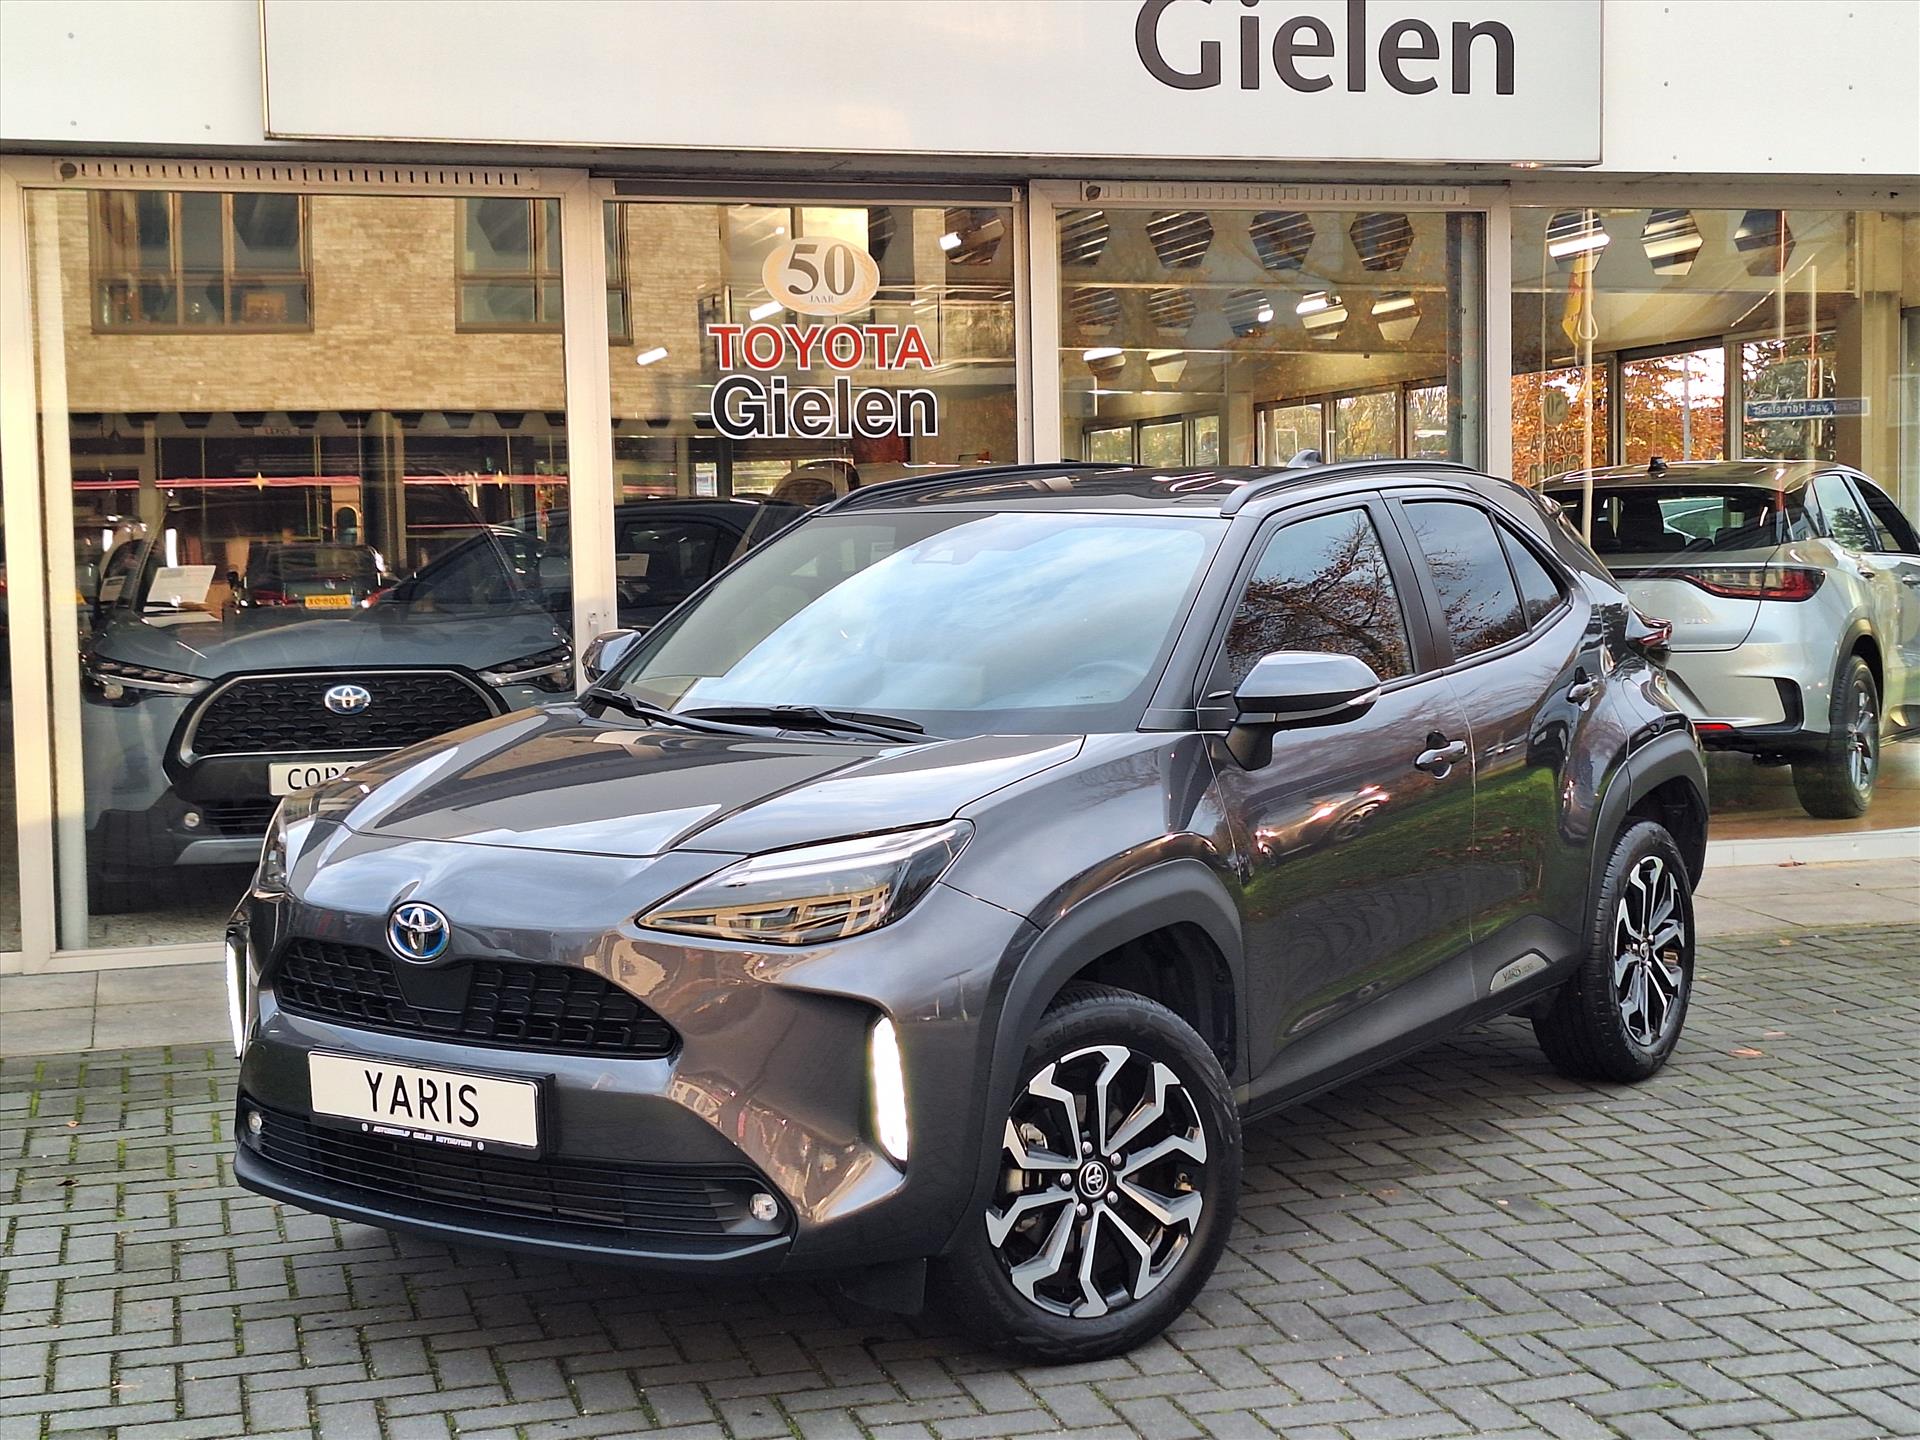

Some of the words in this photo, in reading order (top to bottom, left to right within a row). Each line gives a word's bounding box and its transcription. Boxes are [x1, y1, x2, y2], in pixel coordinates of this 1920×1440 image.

[1135, 0, 1515, 95] Gielen
[788, 243, 855, 296] 50
[808, 294, 835, 303] JAAR
[706, 324, 934, 371] TOYOTA
[712, 374, 938, 440] Gielen
[364, 1070, 479, 1127] YARIS
